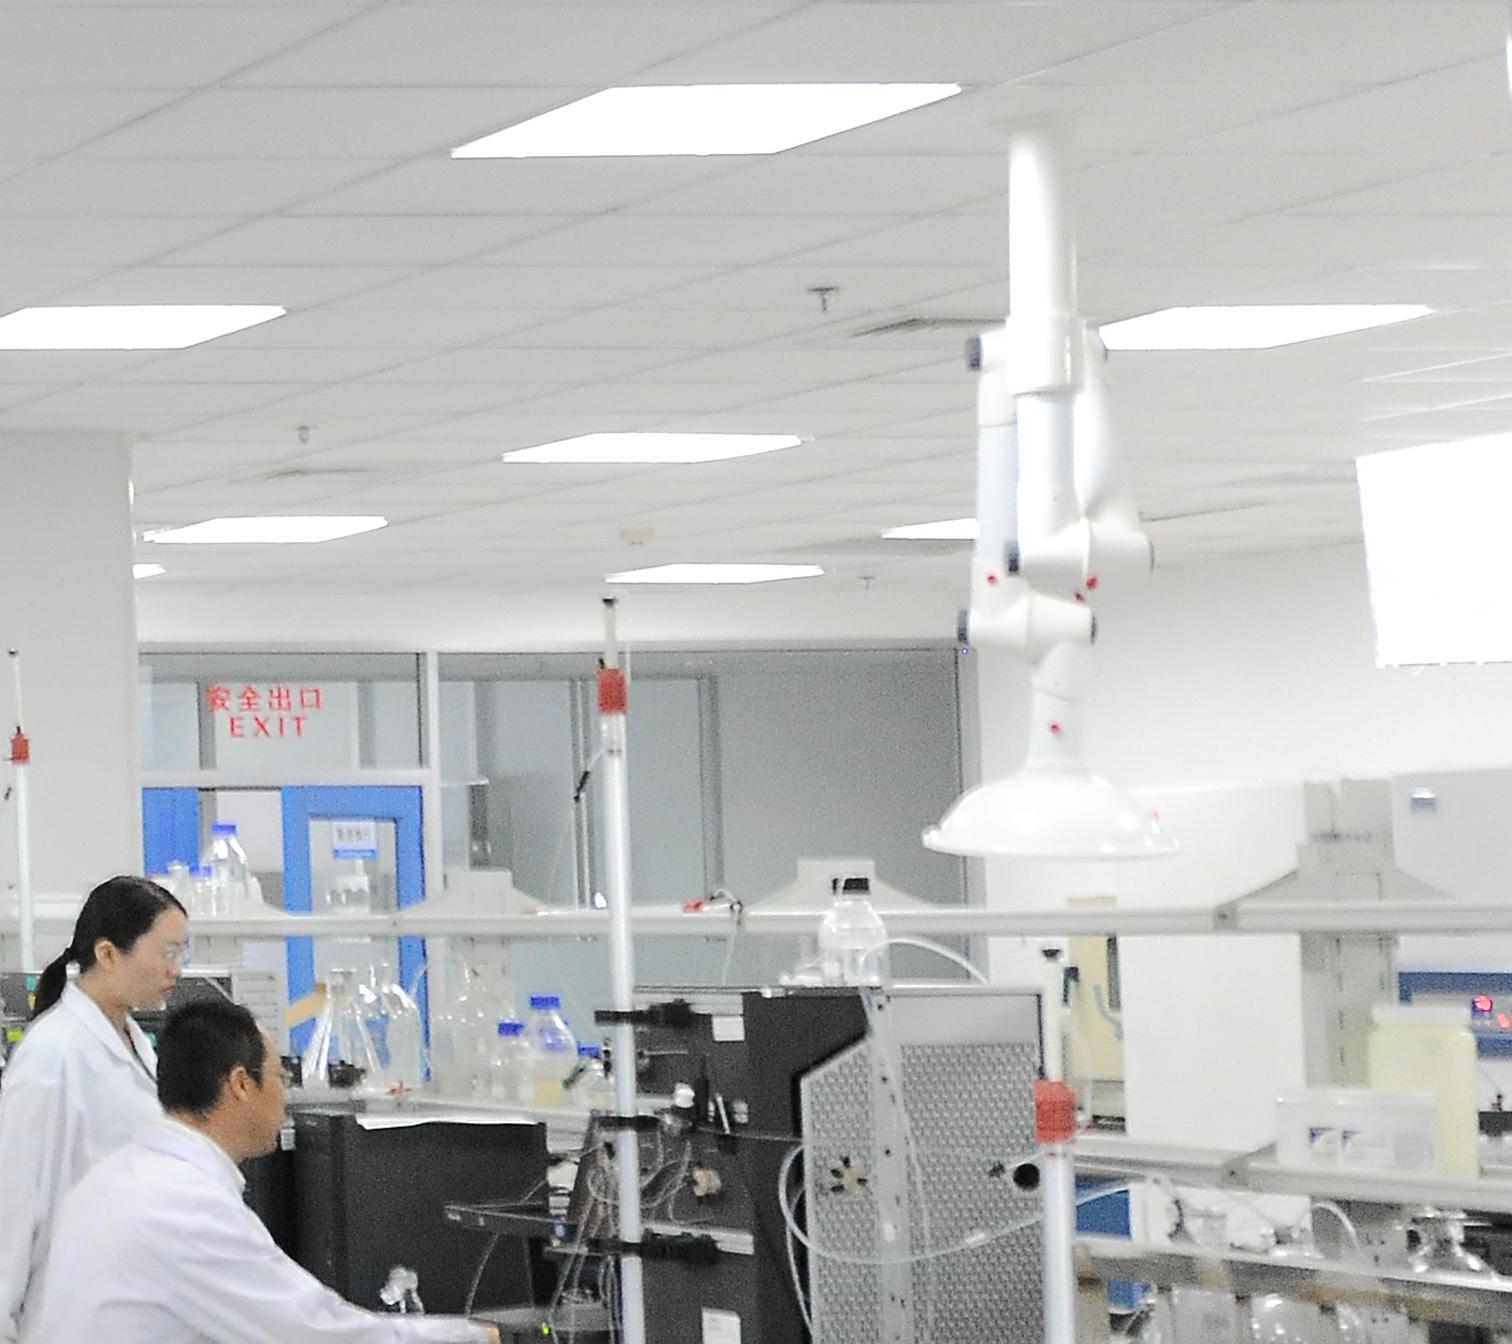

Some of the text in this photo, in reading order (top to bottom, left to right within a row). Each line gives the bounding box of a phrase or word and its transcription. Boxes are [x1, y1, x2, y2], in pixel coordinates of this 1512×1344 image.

[206, 685, 321, 712] 安全出口
[229, 716, 306, 738] EXIT
